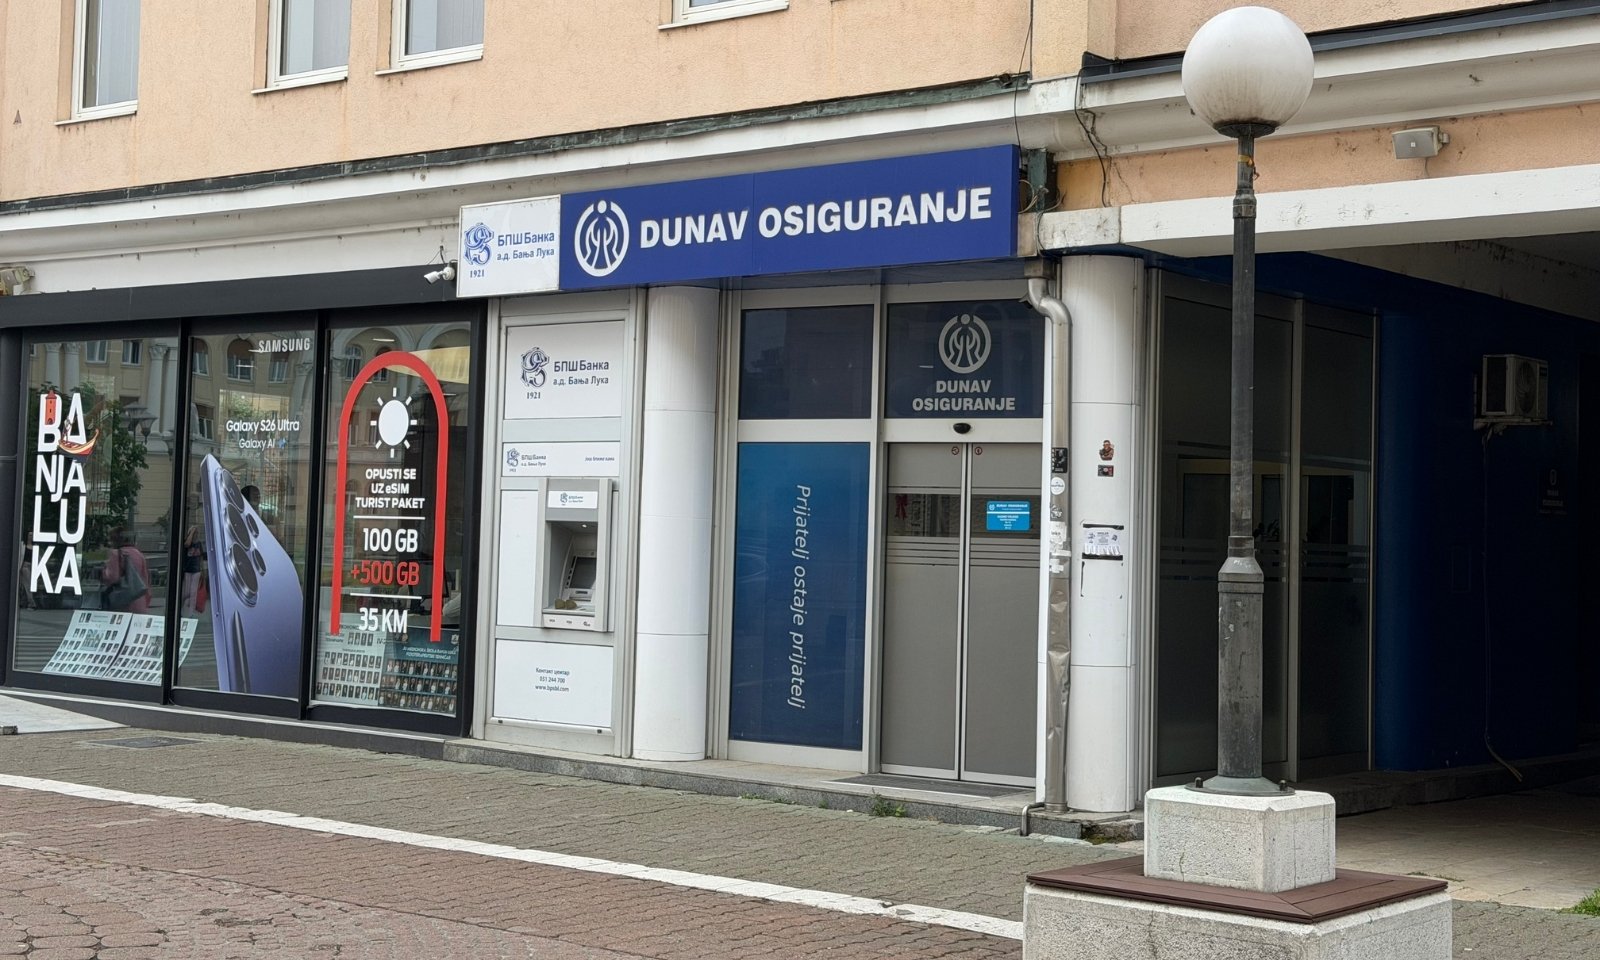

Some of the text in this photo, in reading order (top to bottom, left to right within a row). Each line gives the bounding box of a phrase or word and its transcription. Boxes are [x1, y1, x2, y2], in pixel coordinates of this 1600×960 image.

[640, 186, 993, 249] DUNAV OSIGURANJE
[497, 232, 555, 247] БПШ Банка
[496, 247, 555, 261] а.д. Бања Лука
[469, 269, 485, 278] 1921
[258, 338, 310, 353] SAMSUNG
[553, 360, 609, 372] БПШ Банка
[553, 375, 609, 386] а.д. Бања Лука
[936, 380, 992, 393] DUNAV
[526, 391, 541, 399] 1921
[912, 397, 1016, 411] OSIGURANJE
[226, 418, 300, 435] Galaxy S26 Ultra
[238, 438, 276, 452] Galaxy AI
[34, 454, 87, 503] NJA
[365, 468, 417, 480] OPUSTI SE
[371, 483, 410, 494] UZ eSIM
[355, 497, 425, 509] TURIST PAKET
[32, 494, 87, 545] LU
[363, 527, 418, 553] 100 GB
[29, 545, 83, 596] KA
[350, 559, 420, 586] +500 GB
[787, 485, 811, 709] Prijatelj ostaje prijatelj
[358, 607, 408, 634] 35 KM
